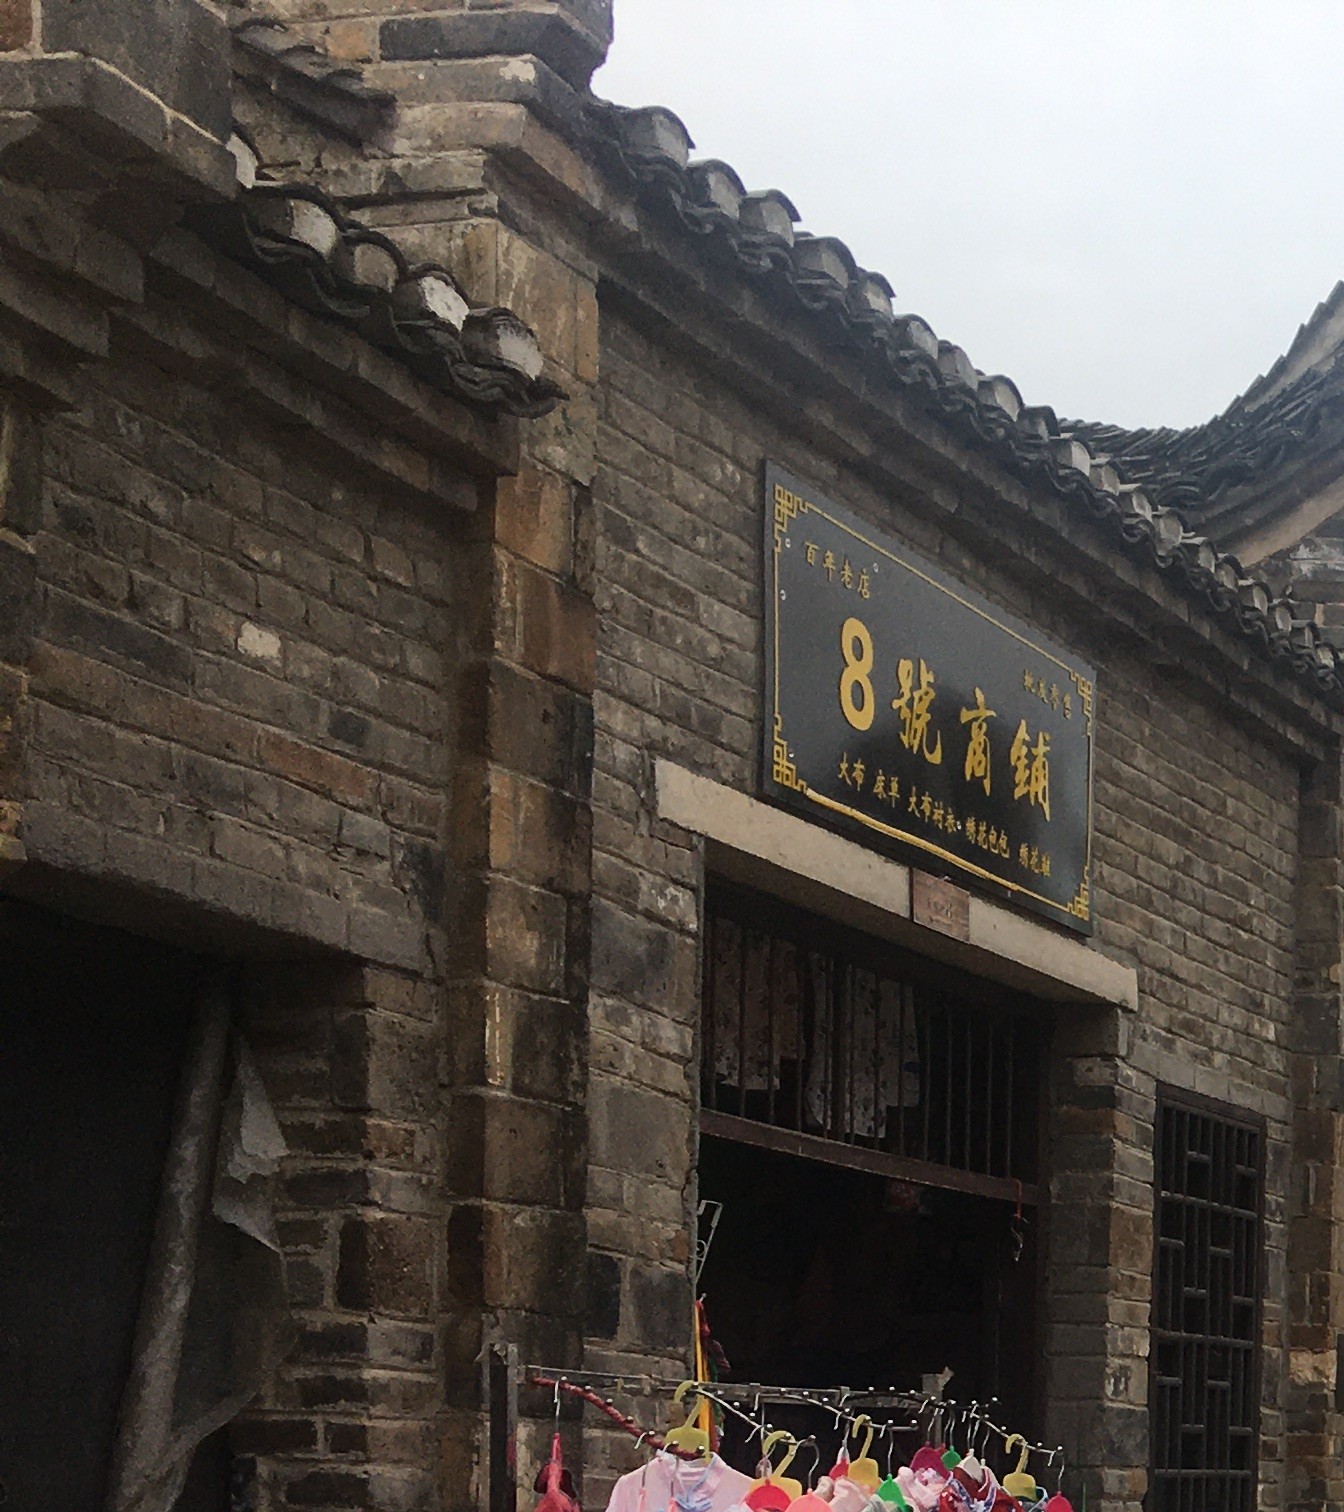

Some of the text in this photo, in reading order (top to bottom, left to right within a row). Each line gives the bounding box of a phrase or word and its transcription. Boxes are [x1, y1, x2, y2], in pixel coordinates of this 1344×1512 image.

[803, 540, 871, 600] 百年老店
[837, 751, 866, 792] 大布
